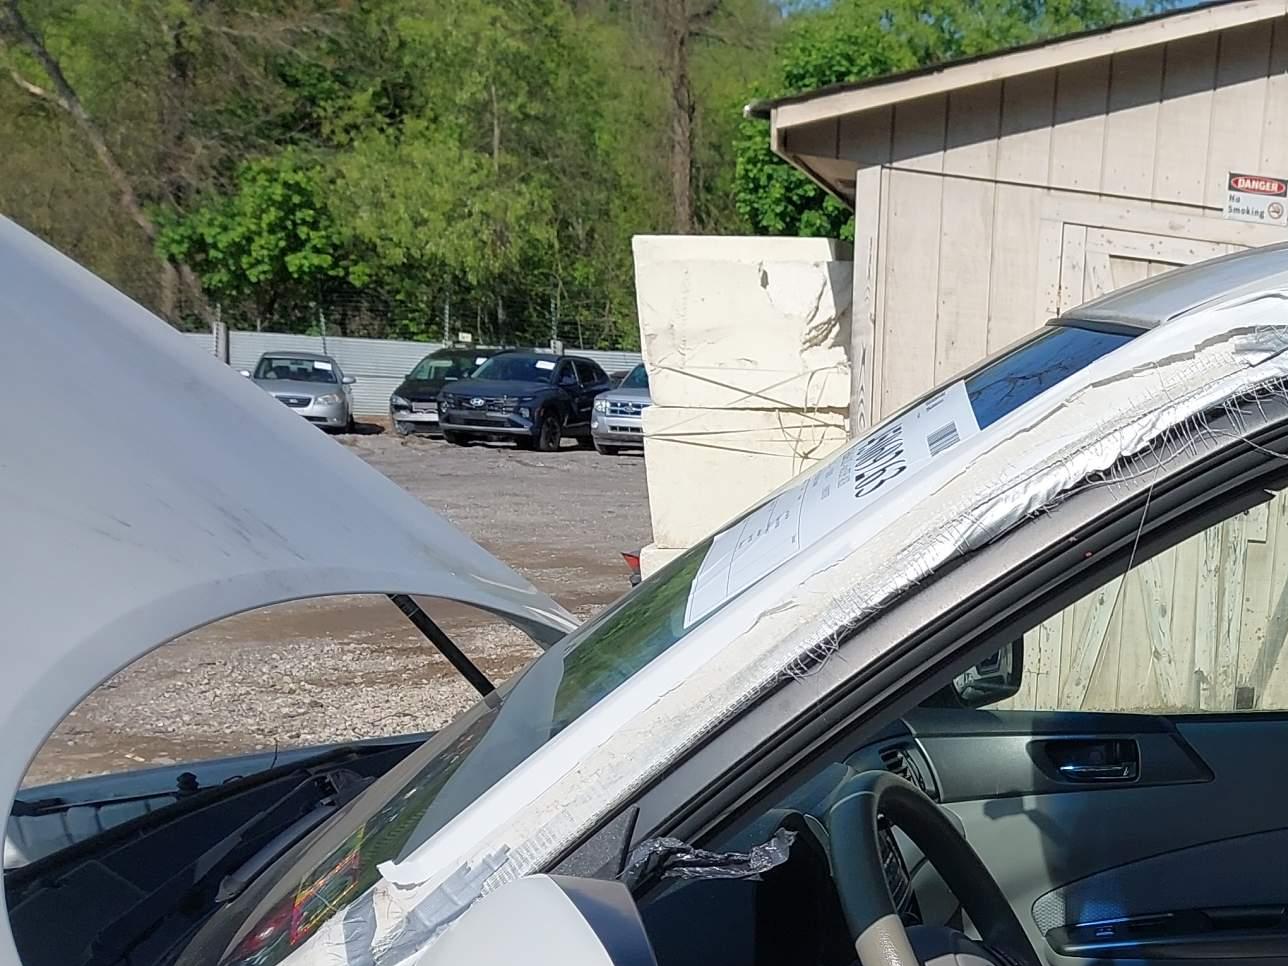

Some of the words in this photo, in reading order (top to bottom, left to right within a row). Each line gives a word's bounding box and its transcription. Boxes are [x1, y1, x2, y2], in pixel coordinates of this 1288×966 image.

[1238, 178, 1279, 193] DANGER
[1229, 194, 1241, 203] No
[1228, 205, 1265, 219] Smoking
